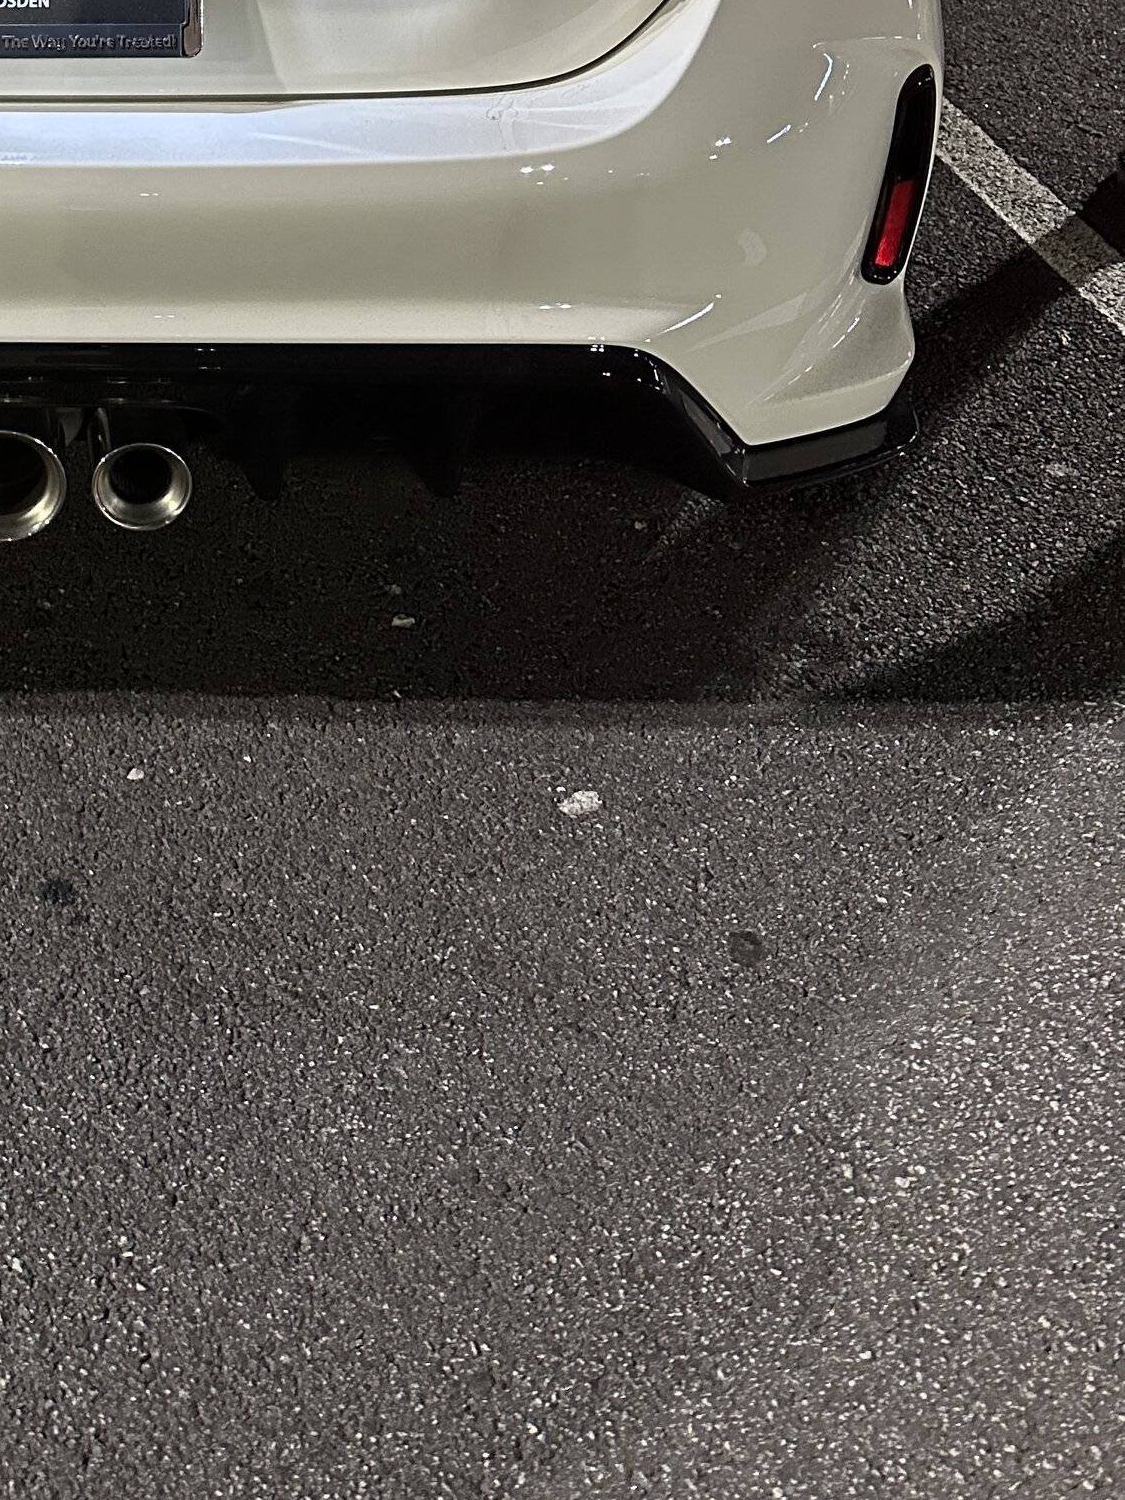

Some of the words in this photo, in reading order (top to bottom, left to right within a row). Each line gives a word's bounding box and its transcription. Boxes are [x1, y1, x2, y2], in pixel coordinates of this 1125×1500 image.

[1, 34, 29, 48] The
[31, 34, 66, 51] Way
[68, 33, 115, 49] You're
[116, 32, 177, 48] Treated!
